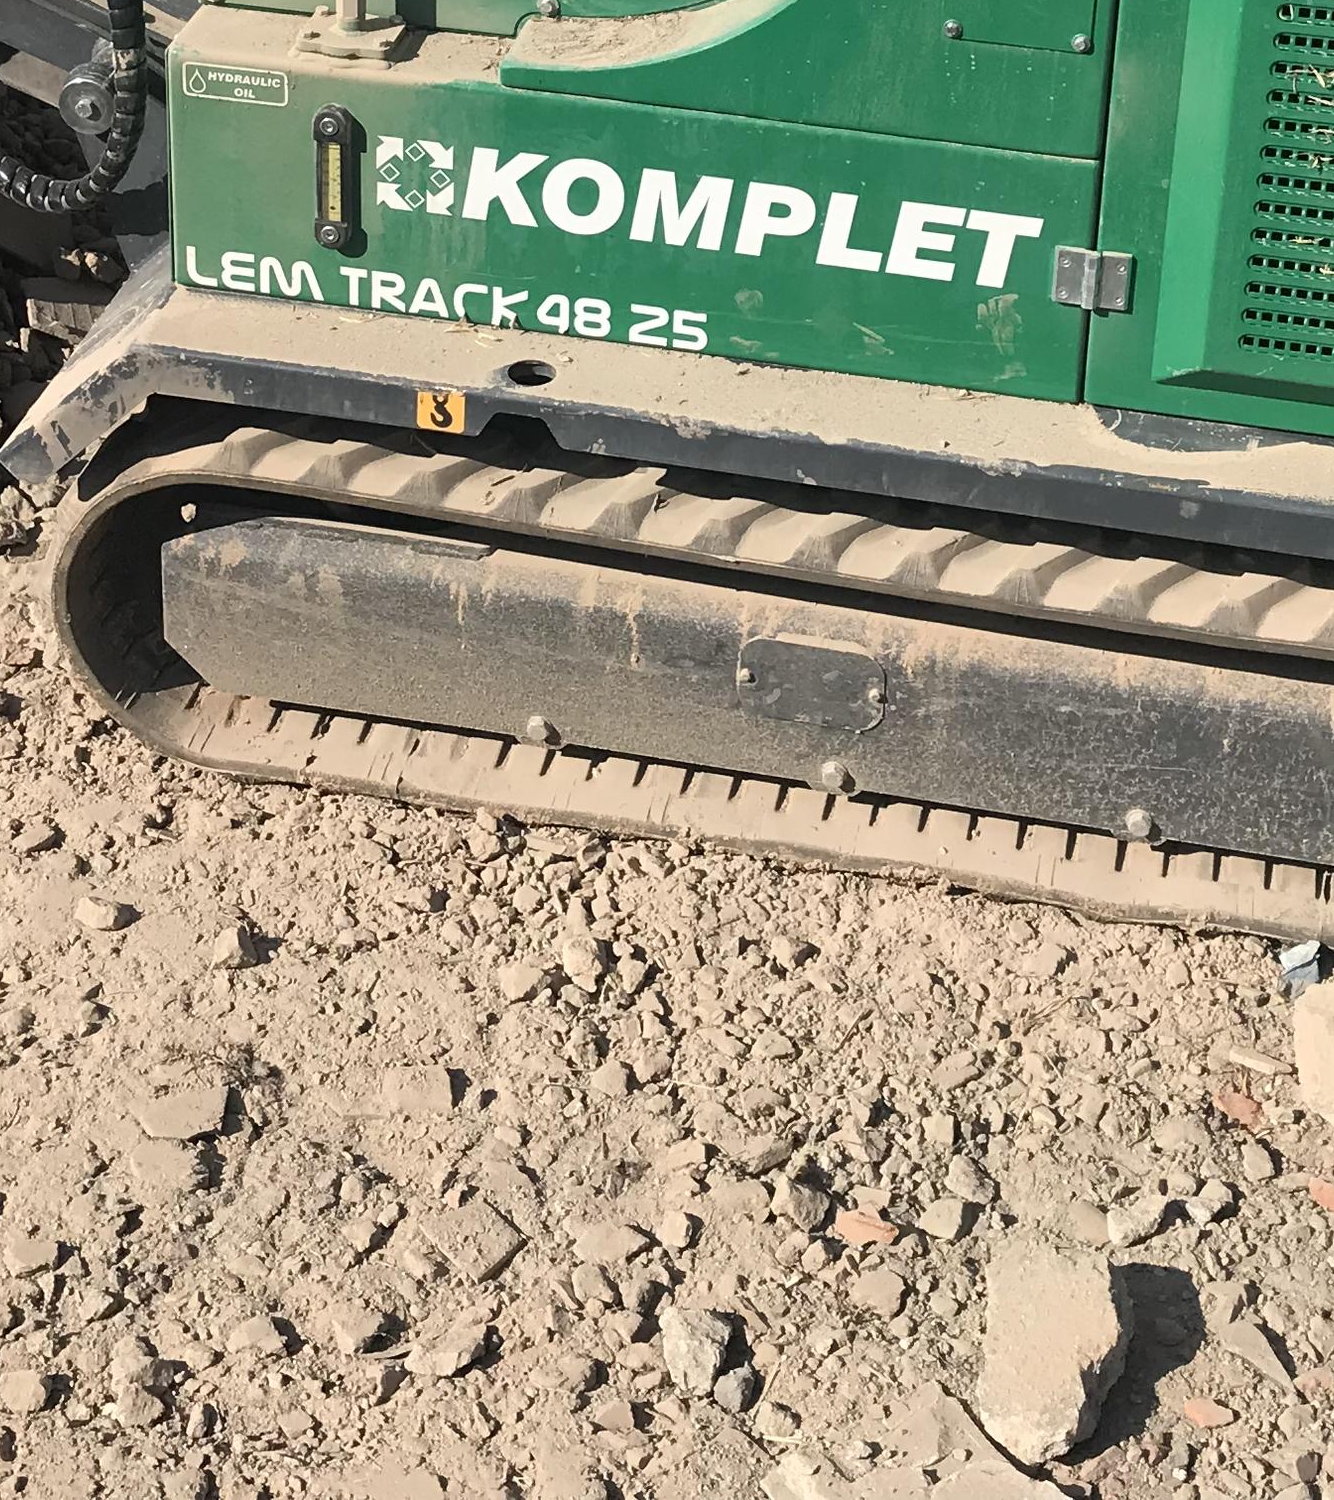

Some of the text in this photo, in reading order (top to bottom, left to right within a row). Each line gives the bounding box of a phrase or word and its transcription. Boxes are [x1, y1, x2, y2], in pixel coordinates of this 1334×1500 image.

[207, 71, 281, 88] HYDRAULIC
[233, 87, 256, 99] OIL
[461, 146, 1044, 289] KOMPLET
[186, 245, 708, 351] LEM TRACK 48 25
